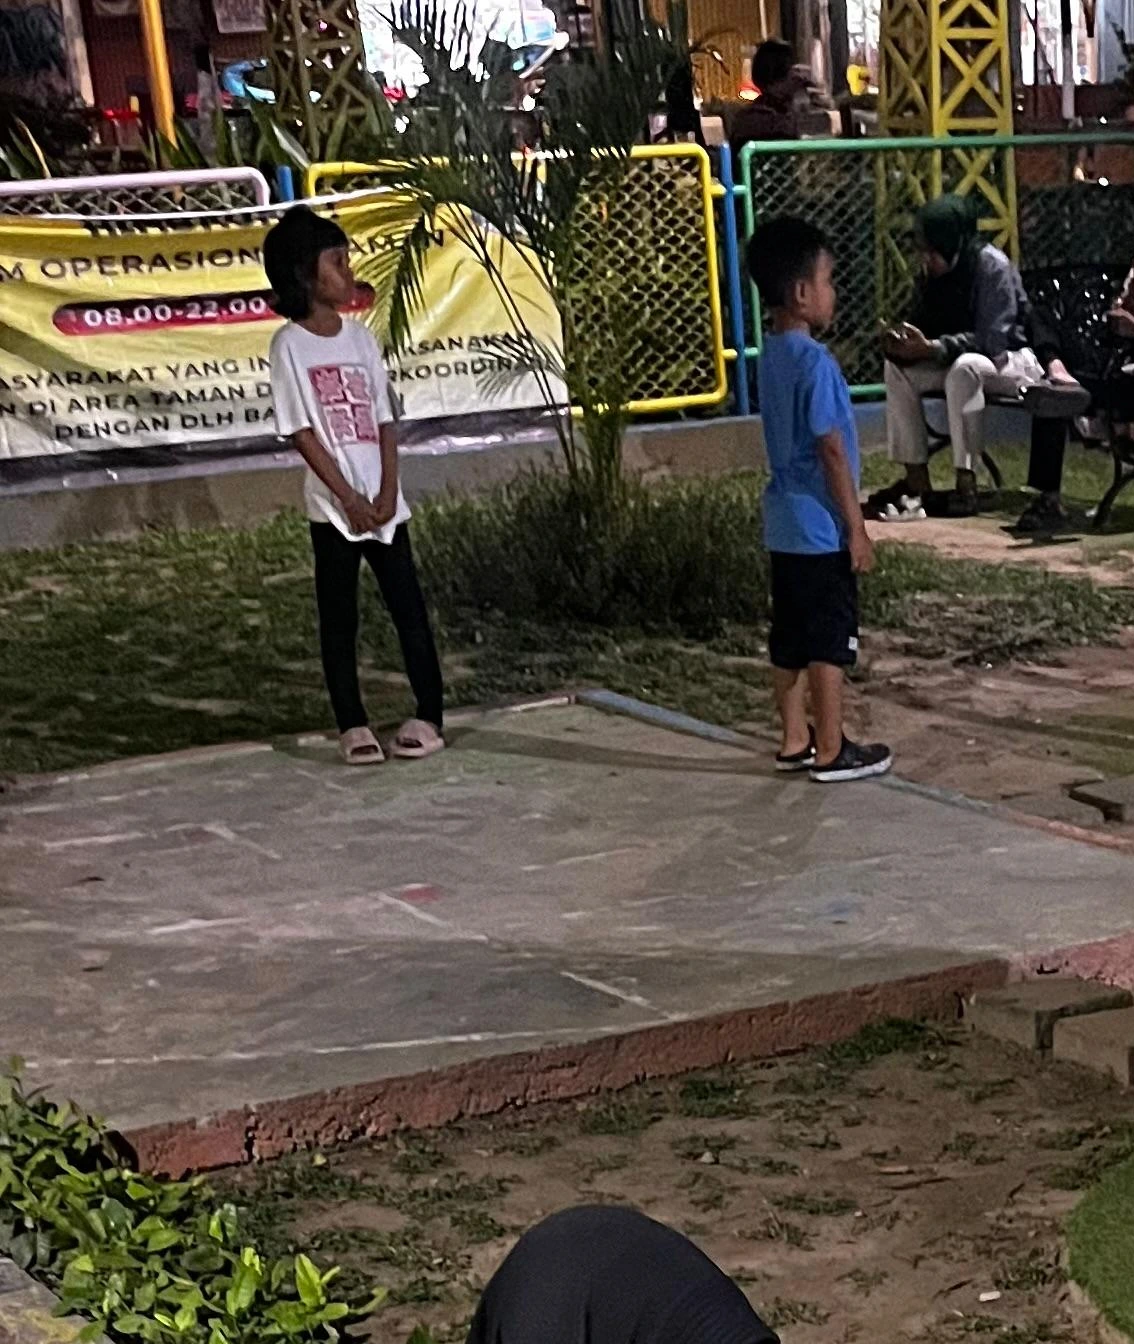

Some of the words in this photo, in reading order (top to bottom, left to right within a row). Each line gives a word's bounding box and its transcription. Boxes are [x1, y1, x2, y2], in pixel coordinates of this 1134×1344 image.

[40, 246, 264, 280] OPERASION
[166, 358, 238, 378] YANG
[28, 401, 57, 417] DI
[67, 391, 142, 414] AREA
[150, 382, 246, 406] TAMAN
[55, 414, 170, 441] DENGAN
[181, 410, 234, 429] DLH
